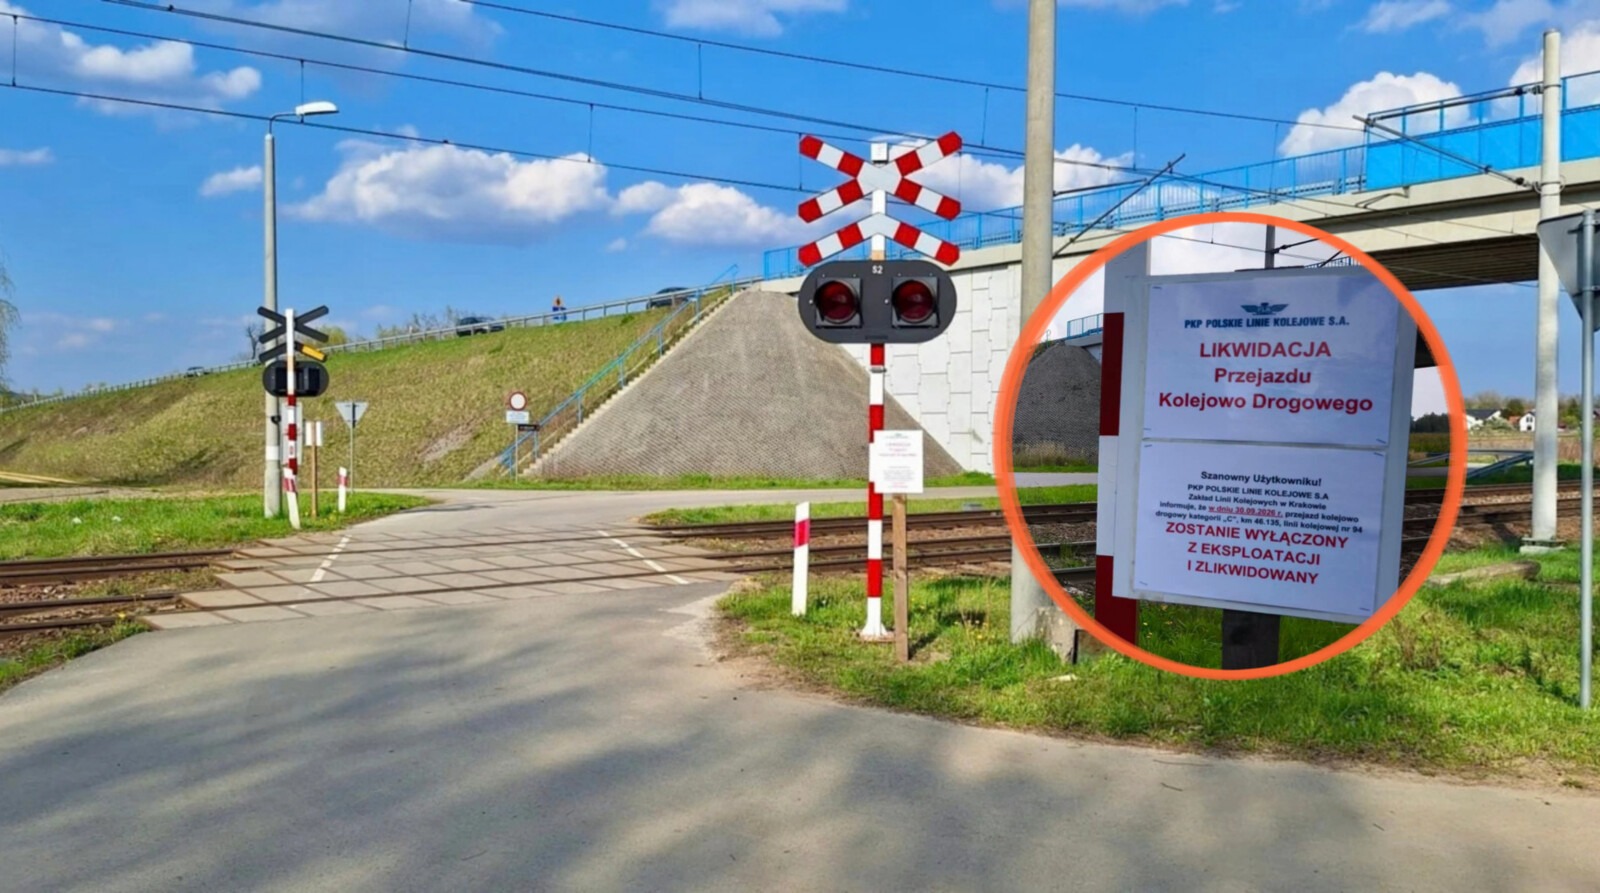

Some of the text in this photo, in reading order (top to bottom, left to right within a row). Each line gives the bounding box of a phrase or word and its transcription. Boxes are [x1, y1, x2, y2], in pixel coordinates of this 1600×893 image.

[872, 265, 883, 274] S2
[1184, 316, 1349, 328] PKP POLSKIE LINIE KOLEJOWE S.A.
[1200, 342, 1331, 358] LIKWIDACJA
[1215, 368, 1311, 387] Przejazdu
[1159, 393, 1373, 415] Kolejowo Drogowego
[1201, 472, 1322, 486] Szanowny Użytkowniku!
[1206, 485, 1240, 493] POLSKIE
[1265, 489, 1311, 499] KOLEJOWE
[1314, 492, 1329, 500] S.A
[1160, 501, 1196, 510] informuje,
[1236, 507, 1275, 517] 30.09.2026
[1285, 511, 1319, 521] przejazd
[1322, 514, 1359, 523] kolejowo
[1215, 495, 1231, 503] Linii
[1234, 496, 1278, 507] Kolejowych
[1289, 501, 1326, 510] Krakowie
[1156, 510, 1186, 519] drogowy
[1189, 512, 1221, 522] kategorii
[1255, 518, 1281, 527] 46.135,
[1284, 520, 1298, 528] linii
[1301, 522, 1339, 532] kolejowej
[1166, 522, 1349, 548] ZOSTANIE WYŁĄCZONY
[1188, 542, 1320, 565] Z EKSPLOATACJI
[1188, 560, 1319, 584] I ZLIKWIDOWANY
